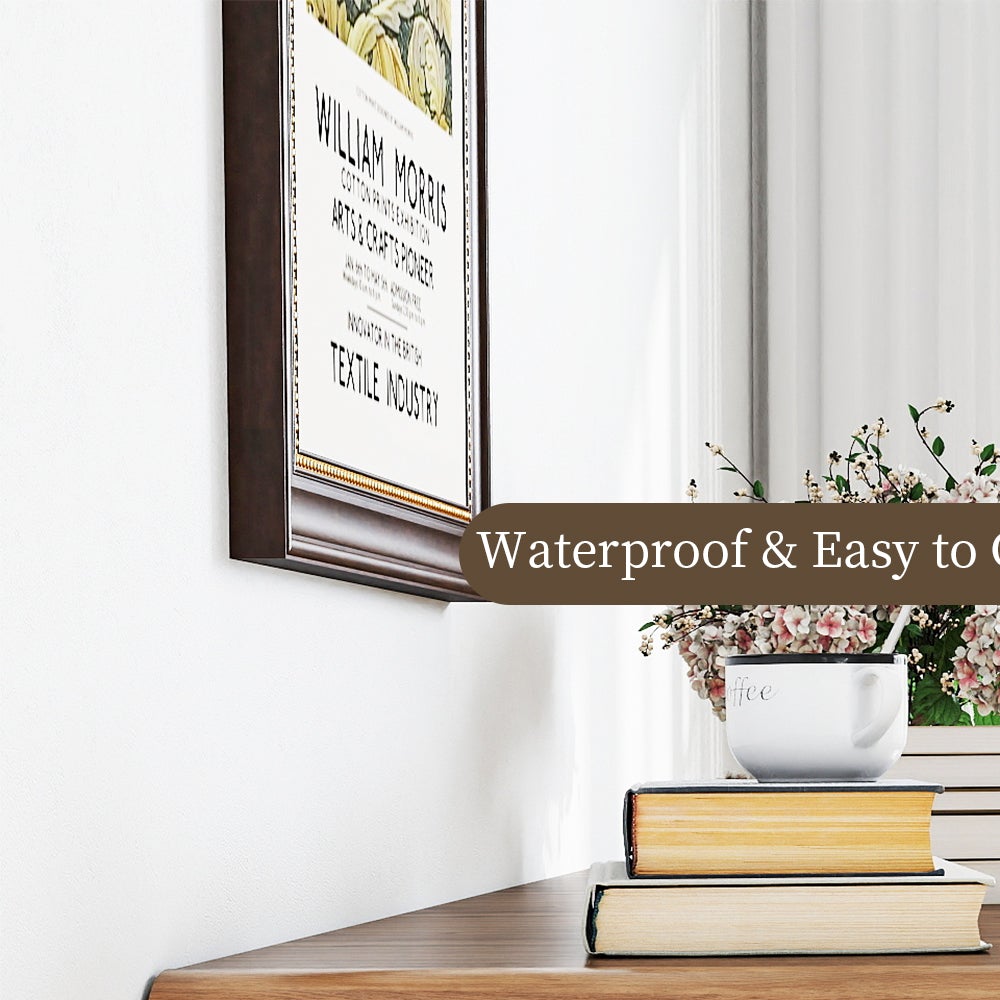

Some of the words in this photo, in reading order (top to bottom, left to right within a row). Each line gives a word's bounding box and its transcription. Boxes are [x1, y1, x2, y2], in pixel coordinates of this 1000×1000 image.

[315, 84, 384, 187] WILLIAM
[395, 147, 447, 233] MORRIS
[331, 197, 357, 242] ARTS
[357, 213, 365, 246] &
[366, 219, 400, 269] CRAFTS
[401, 241, 435, 290] PIONEER
[341, 166, 371, 205] COTTON
[396, 204, 430, 247] EXHIBITION
[347, 311, 382, 348] INNOVATOR
[384, 330, 391, 352] IN
[391, 333, 402, 357] THE
[330, 340, 380, 402] TEXTILE
[386, 368, 439, 428] INDUSTRY
